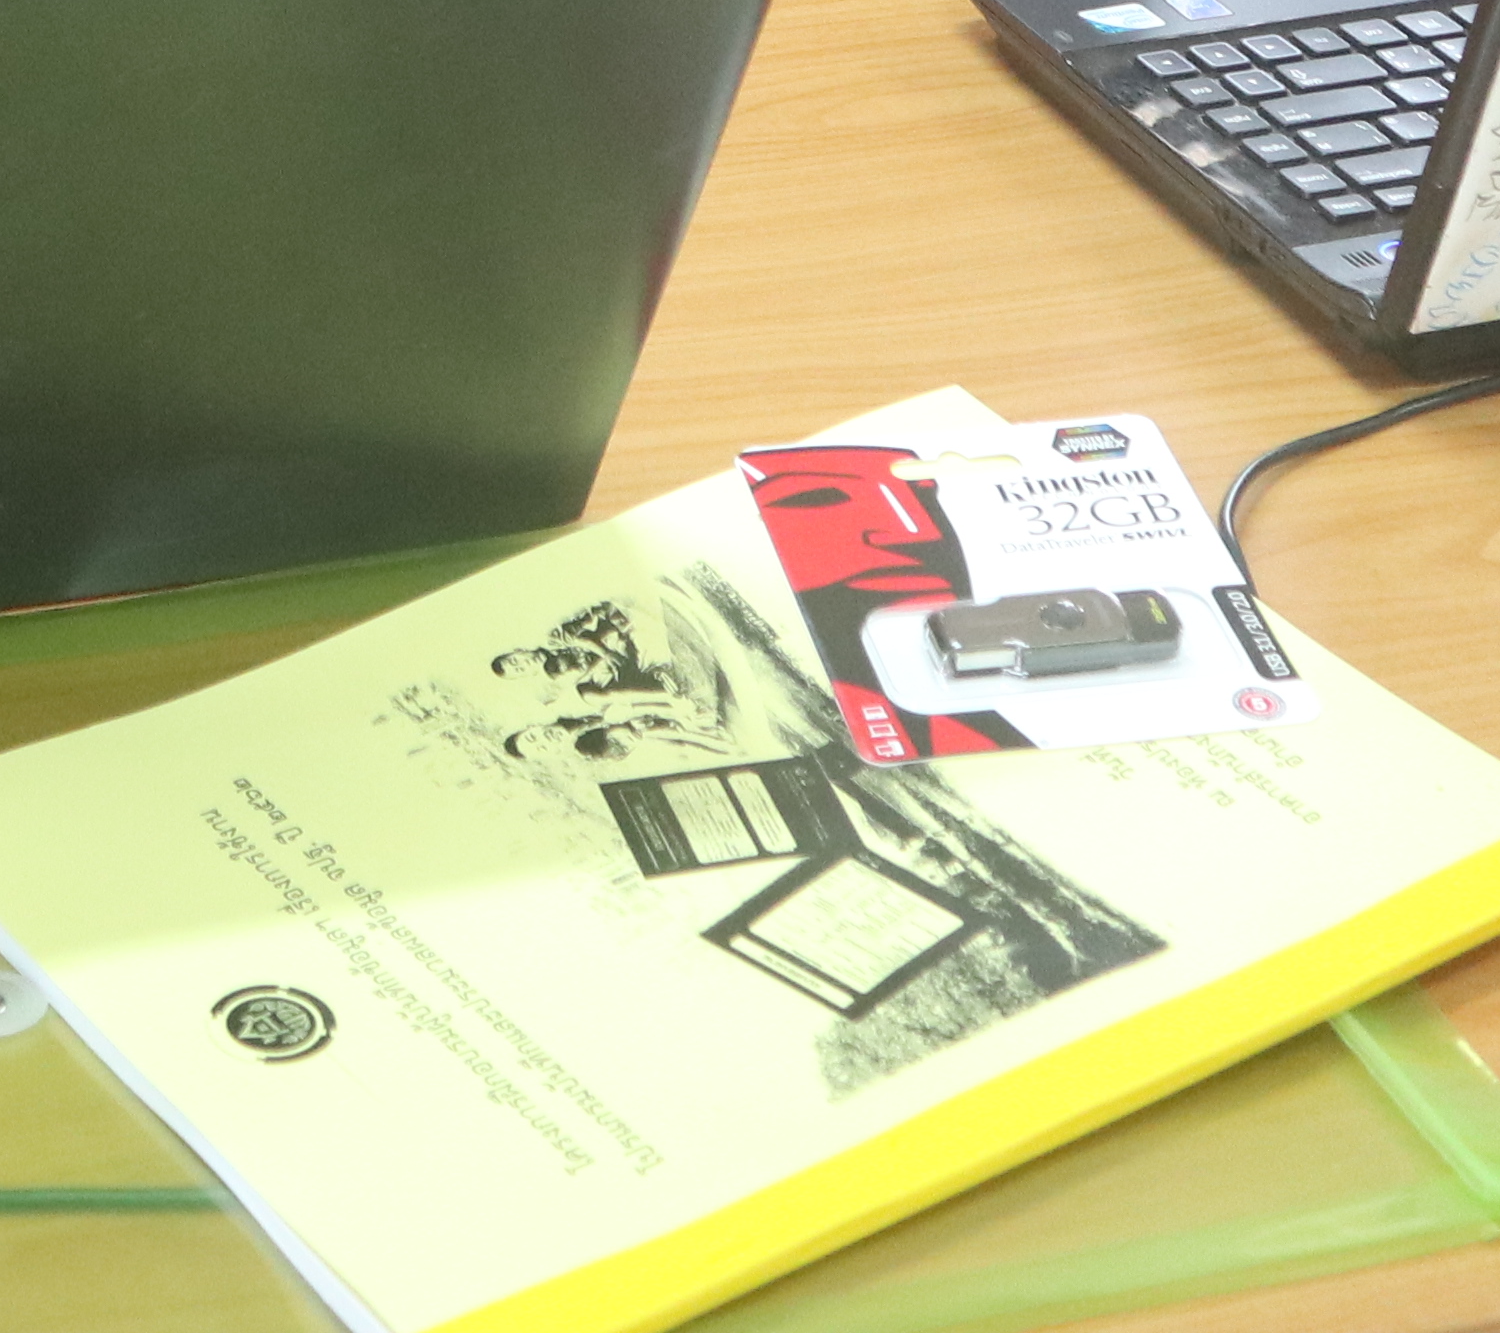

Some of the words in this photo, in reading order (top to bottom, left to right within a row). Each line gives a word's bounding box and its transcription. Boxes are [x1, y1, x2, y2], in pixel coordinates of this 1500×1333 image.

[995, 469, 1158, 503] Kingston
[1018, 493, 1181, 536] 32GB
[1000, 534, 1115, 554] DataTraveler
[1263, 652, 1290, 676] USB
[233, 778, 287, 825] ๒๕๖๒
[1210, 790, 1235, 807] ณ
[274, 826, 303, 846] ปี
[199, 808, 321, 916] เรื่องการใช้งาน
